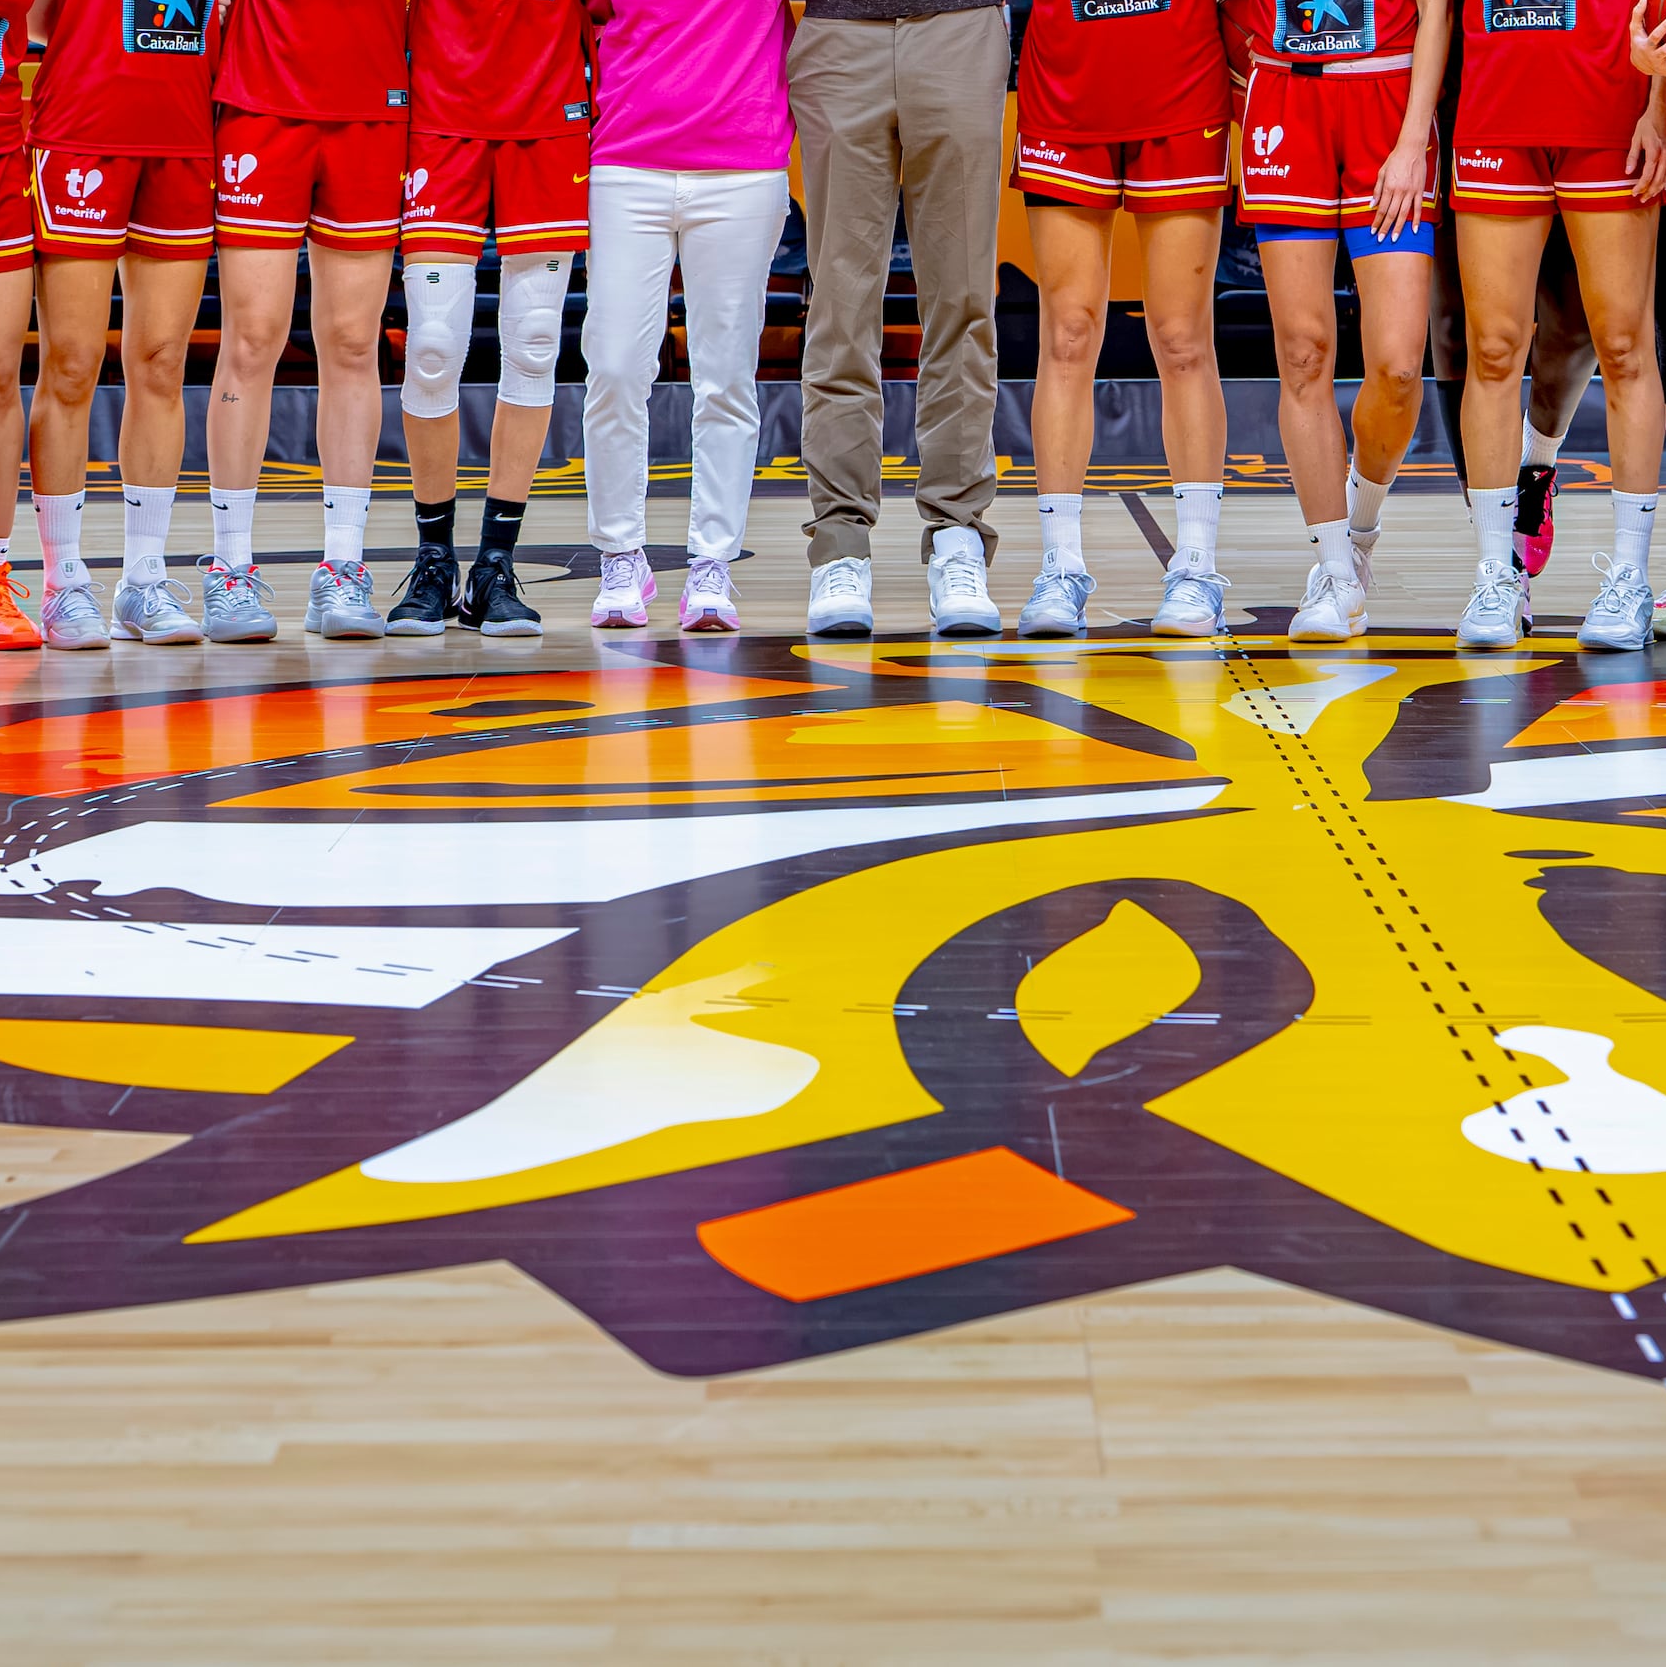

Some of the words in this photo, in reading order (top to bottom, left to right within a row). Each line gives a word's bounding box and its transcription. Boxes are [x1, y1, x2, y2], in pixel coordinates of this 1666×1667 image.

[1492, 10, 1563, 27] CaixaBank
[136, 32, 200, 53] CaixaBank
[1285, 36, 1362, 52] CaixaBank
[1022, 144, 1067, 165] tenerife!
[1247, 164, 1290, 178] tenerife!
[1459, 157, 1503, 172] tenerife!
[55, 204, 106, 222] tenerife!
